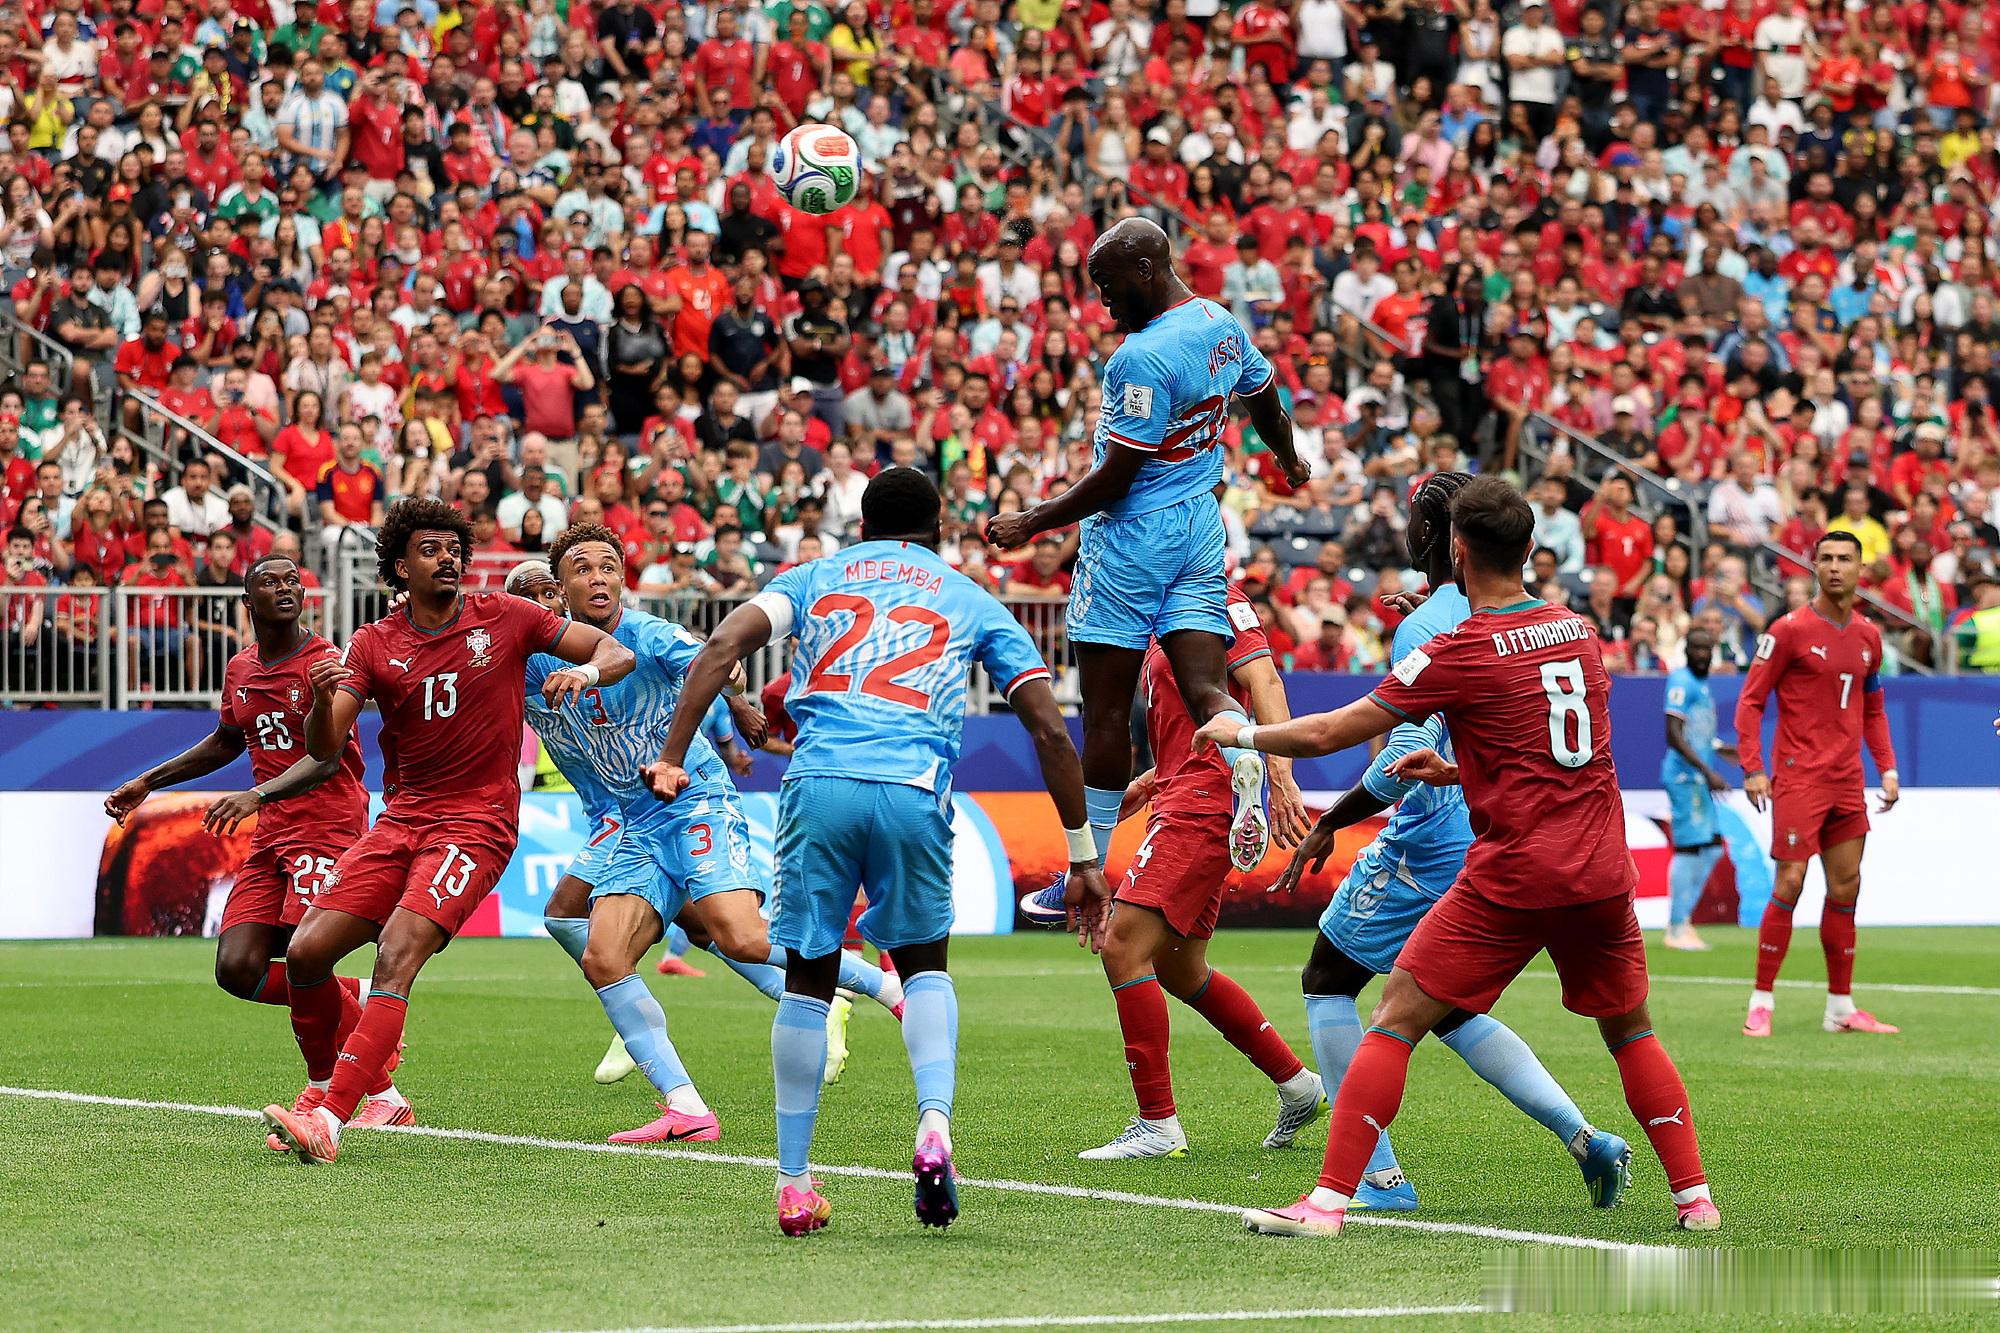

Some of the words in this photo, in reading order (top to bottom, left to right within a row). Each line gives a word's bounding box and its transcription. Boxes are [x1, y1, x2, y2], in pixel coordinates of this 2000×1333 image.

[846, 560, 943, 595] MBEMBA
[807, 593, 950, 712] 22
[421, 671, 458, 720] 13
[584, 687, 608, 725] 3
[1839, 672, 1853, 710] 7
[256, 711, 293, 750] 25
[1539, 657, 1593, 768] 8
[589, 816, 621, 848] 7
[687, 823, 712, 857] 3
[1136, 824, 1162, 868] 4
[293, 854, 335, 896] 25
[431, 844, 477, 897] 13
